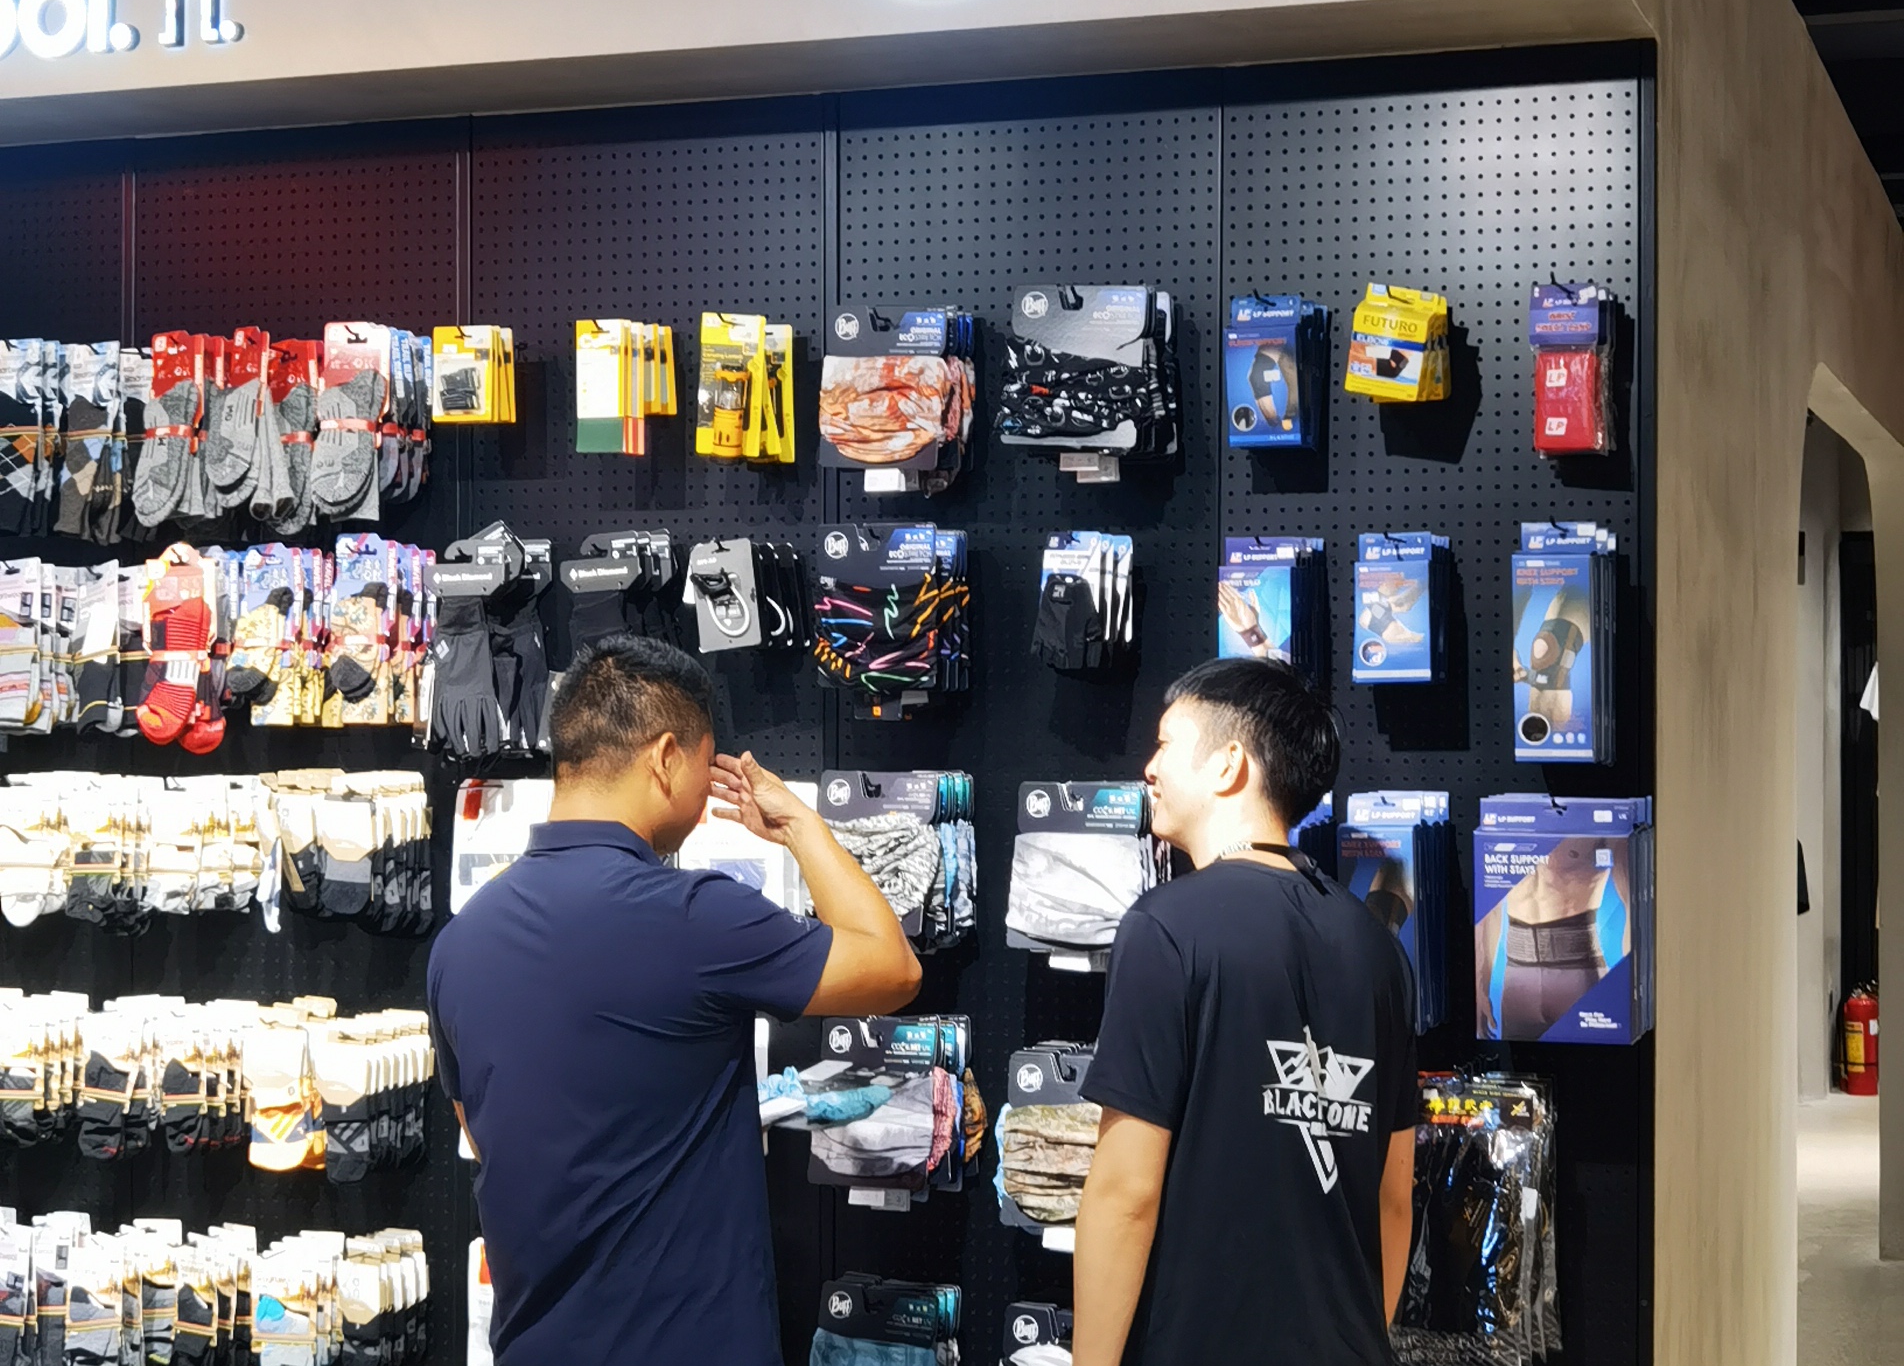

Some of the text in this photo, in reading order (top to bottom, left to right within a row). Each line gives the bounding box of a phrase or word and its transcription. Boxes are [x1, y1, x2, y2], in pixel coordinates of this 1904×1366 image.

[1363, 314, 1418, 333] FUTURO
[1549, 373, 1565, 383] LP
[1548, 421, 1565, 431] LP
[1484, 853, 1549, 865] BACK SUPPORT
[1484, 864, 1537, 875] WITH STAYS
[830, 1295, 852, 1317] Buff
